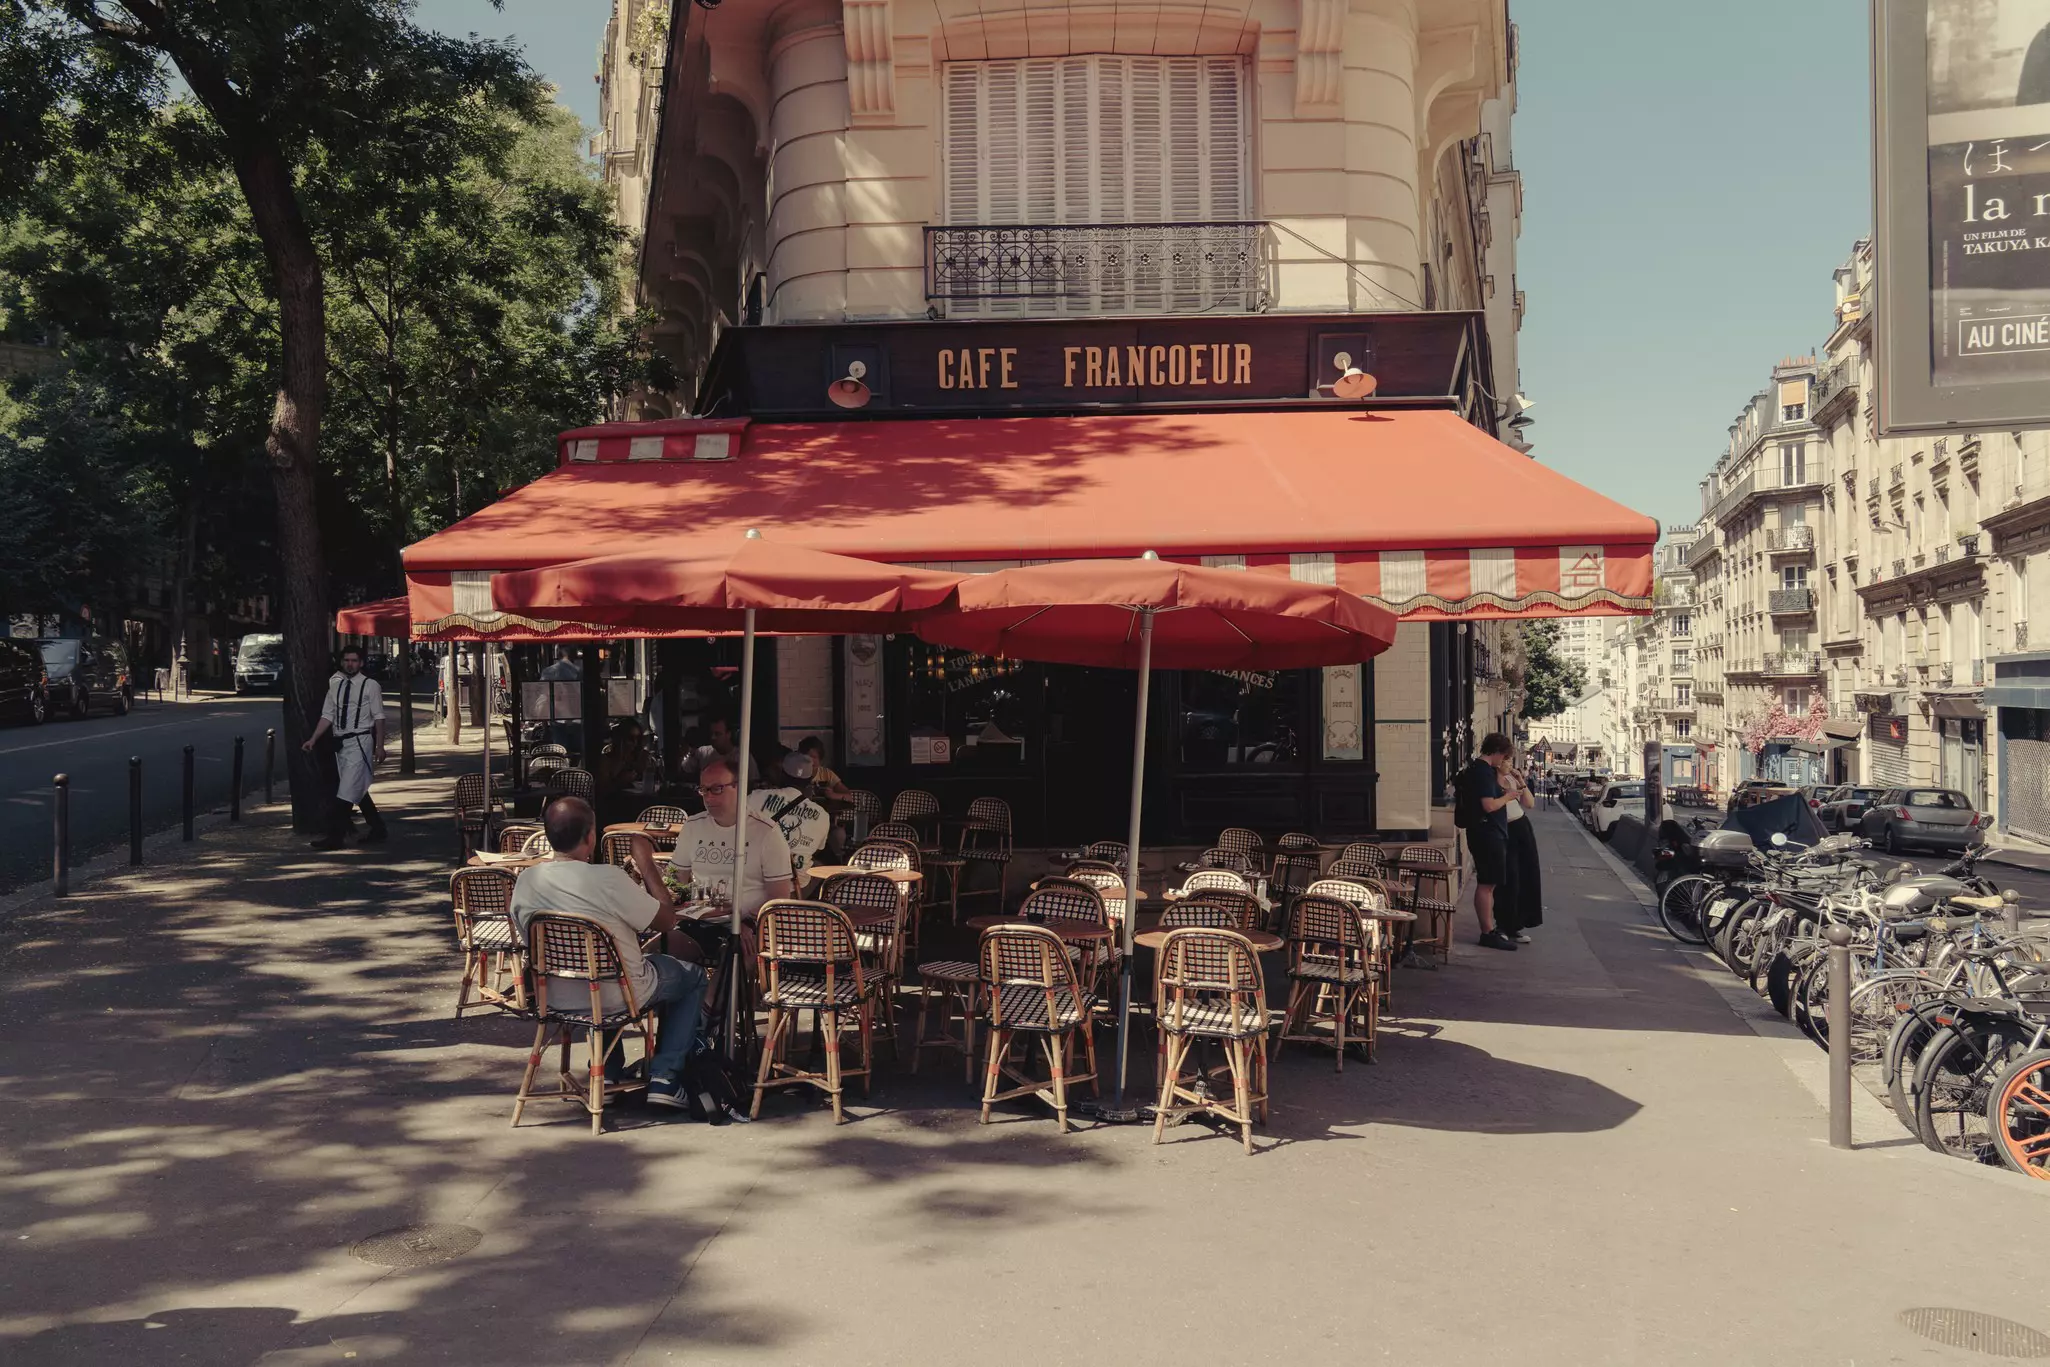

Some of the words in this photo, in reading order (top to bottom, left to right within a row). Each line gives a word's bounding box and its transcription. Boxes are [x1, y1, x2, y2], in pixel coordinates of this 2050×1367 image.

[1963, 139, 2050, 176] ほ
[1963, 184, 2011, 223] la
[1963, 232, 1980, 241] UN
[1981, 230, 2009, 239] FILM
[2010, 228, 2026, 237] DE
[1963, 239, 2031, 255] TAKUYA
[2034, 237, 2050, 249] K
[1967, 325, 1995, 349] AU
[2001, 316, 2049, 346] CINÉ
[937, 347, 1019, 389] CAFE
[1063, 343, 1252, 388] FRANCOEUR
[761, 794, 820, 821] Milaukee
[698, 839, 749, 847] PARS
